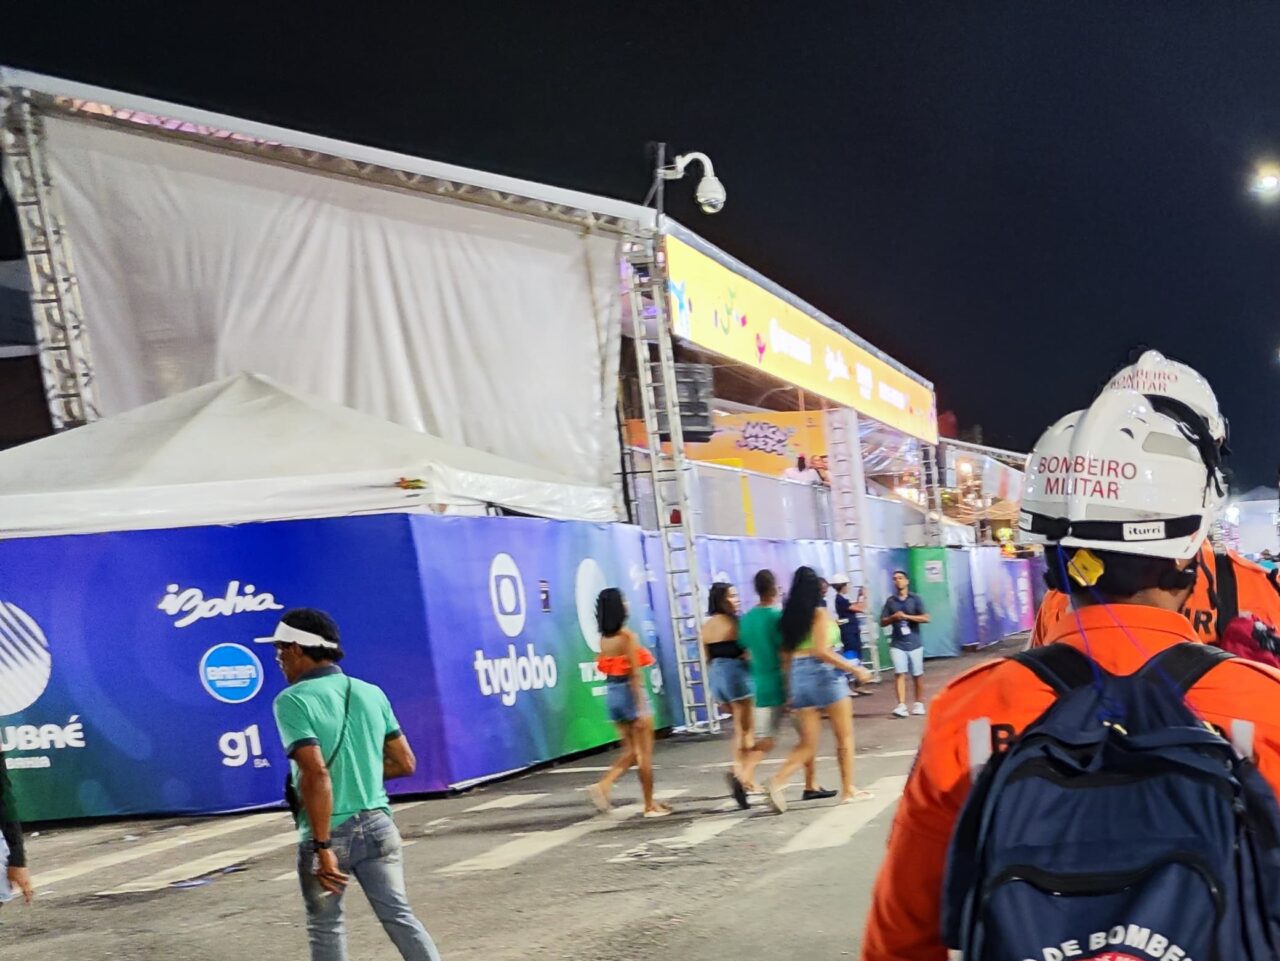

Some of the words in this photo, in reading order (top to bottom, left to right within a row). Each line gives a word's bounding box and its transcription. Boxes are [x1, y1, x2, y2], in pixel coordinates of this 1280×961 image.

[1038, 455, 1138, 480] BOMBEIRO
[1044, 477, 1120, 500] MILITAR
[1128, 526, 1161, 536] iturri
[218, 724, 262, 767] g1
